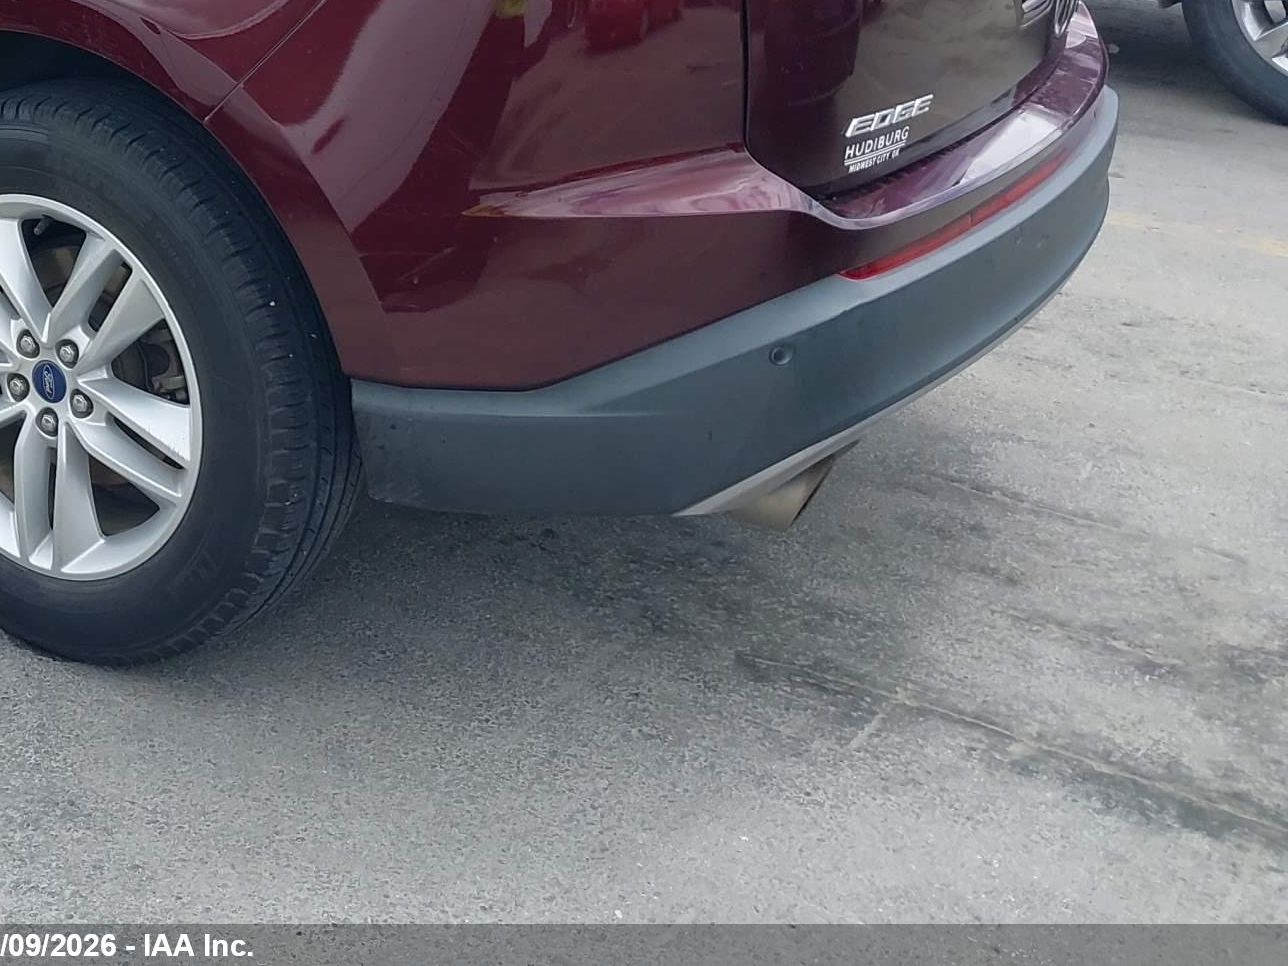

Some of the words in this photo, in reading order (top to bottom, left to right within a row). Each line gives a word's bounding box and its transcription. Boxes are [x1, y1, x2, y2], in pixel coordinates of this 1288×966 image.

[845, 94, 934, 138] EDGE
[844, 126, 910, 160] HUDIBURG
[876, 152, 891, 165] CITY
